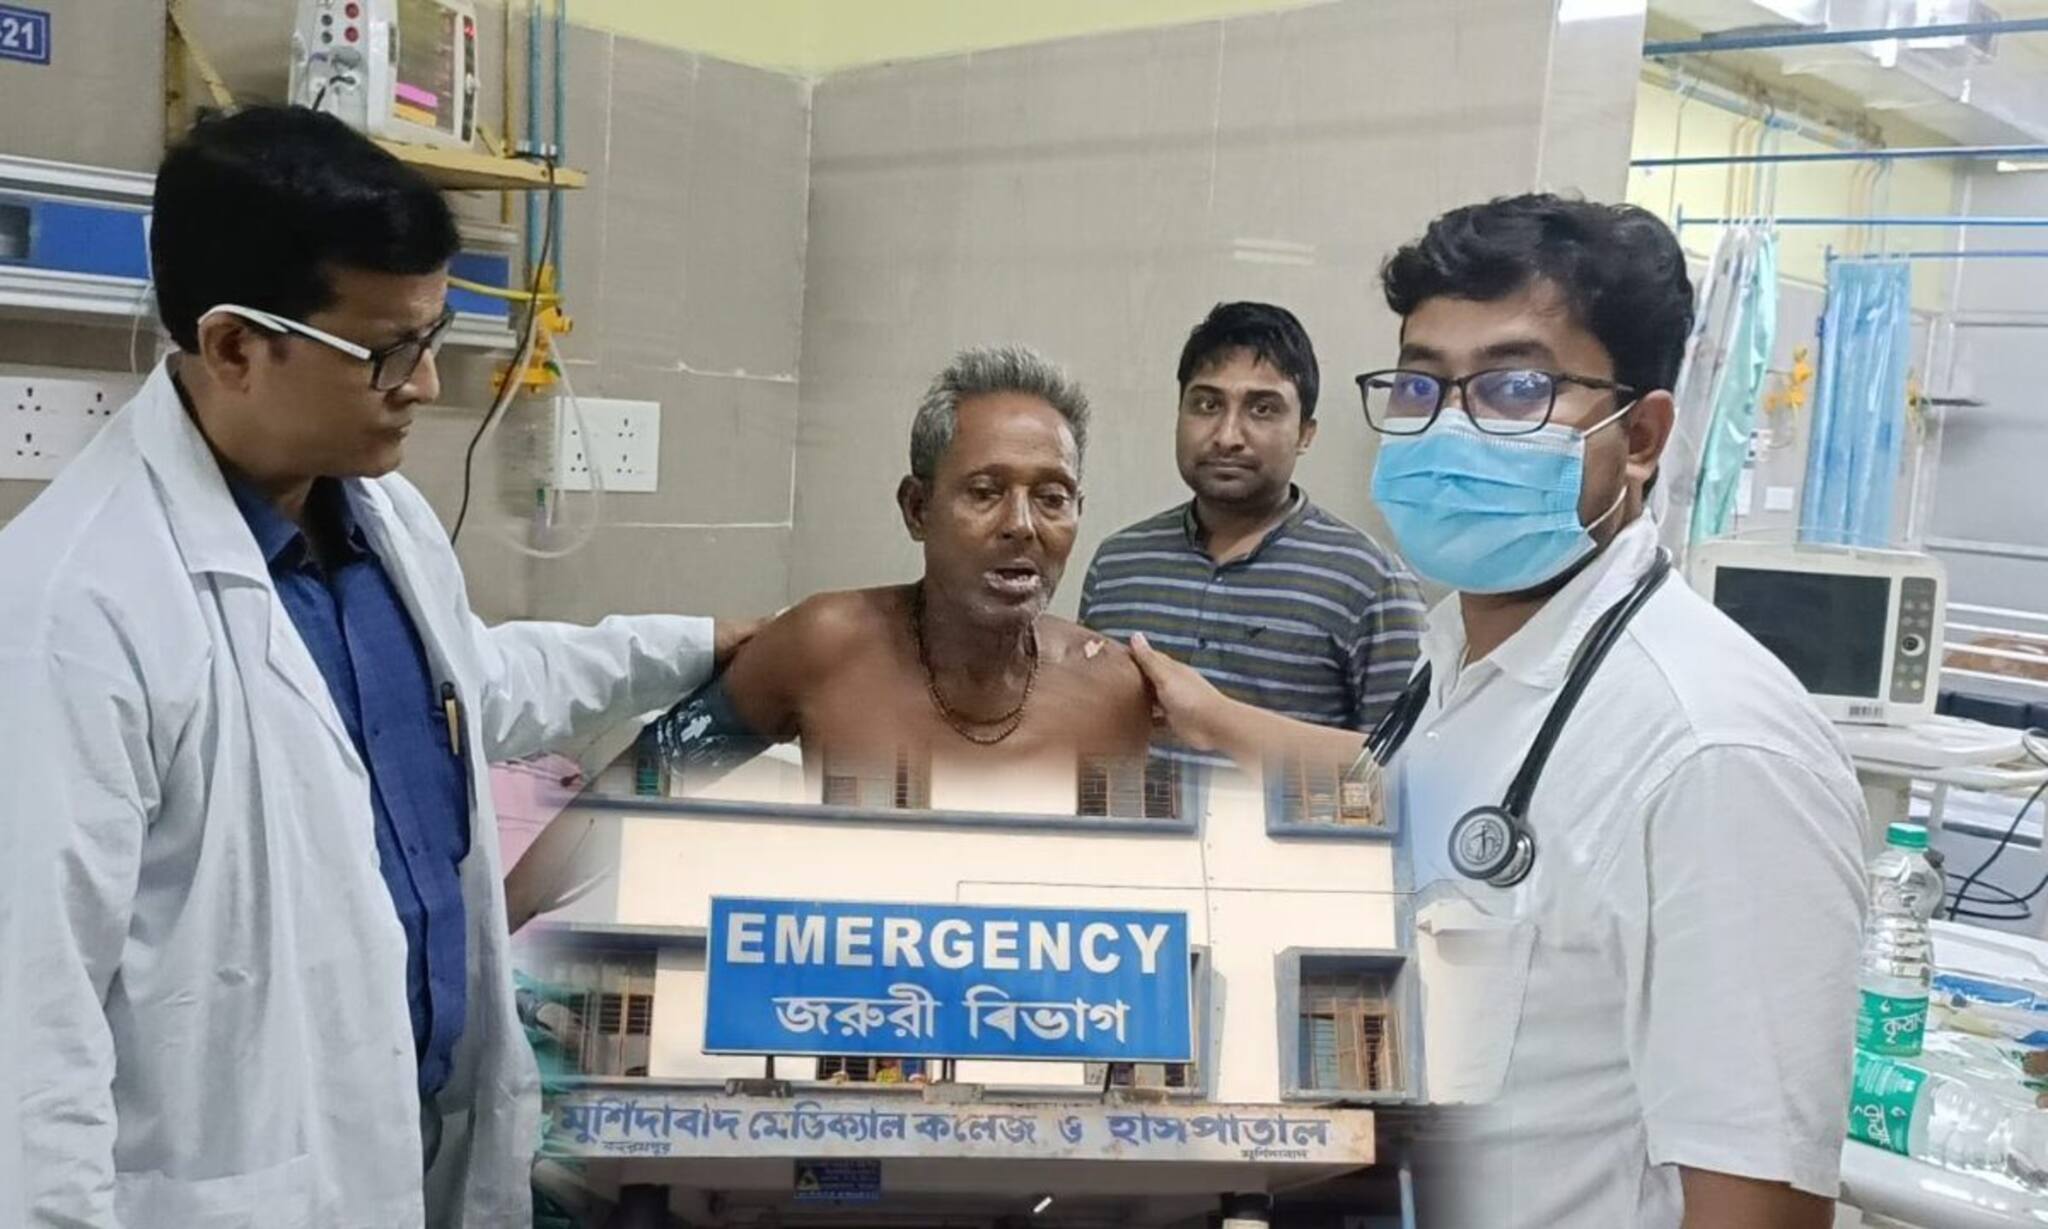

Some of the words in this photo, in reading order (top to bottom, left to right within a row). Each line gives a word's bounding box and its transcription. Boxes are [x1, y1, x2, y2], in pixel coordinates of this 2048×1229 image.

[726, 911, 1171, 974] EMERGENCY
[771, 983, 942, 1039] জরুরী
[961, 983, 1131, 1043] বিভাগ
[749, 1101, 907, 1143] মেডিক্যাল
[912, 1111, 1038, 1144] কলেজ
[1059, 1115, 1084, 1144] ও
[1106, 1111, 1331, 1147] হাসপাতাল
